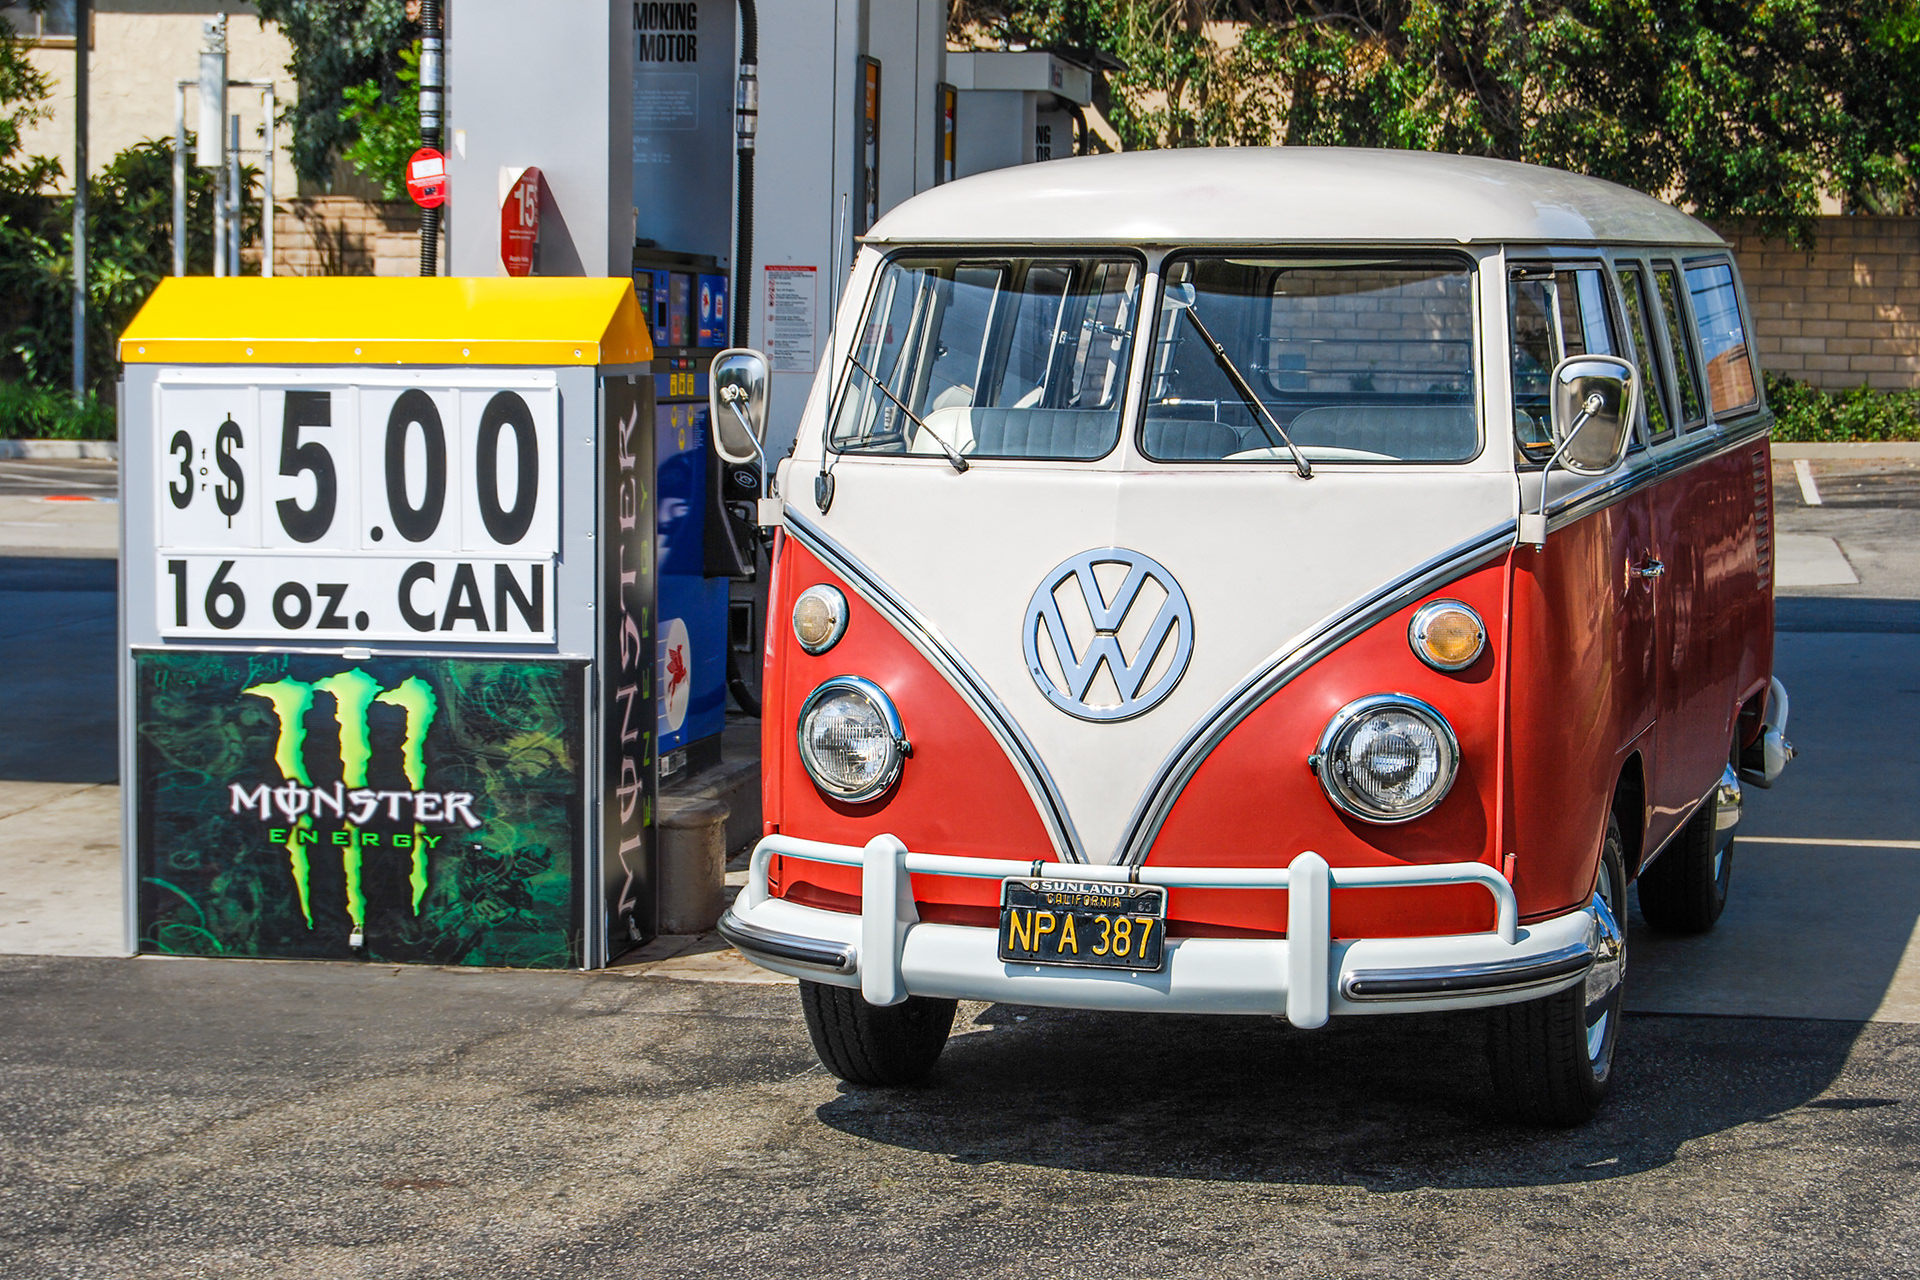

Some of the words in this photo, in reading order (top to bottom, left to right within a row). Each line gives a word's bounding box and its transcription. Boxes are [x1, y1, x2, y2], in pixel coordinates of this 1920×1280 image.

[640, 33, 697, 63] MOTOR
[169, 429, 194, 510] 3
[200, 448, 208, 491] for
[168, 560, 246, 630] 16
[272, 581, 370, 631] oz.
[398, 561, 544, 632] CAN
[616, 402, 643, 915] MONSTER
[1023, 546, 1195, 724] VW
[228, 780, 482, 828] MONSTER
[269, 828, 443, 849] ENERGY
[1041, 881, 1126, 896] SUNLAND
[1046, 893, 1121, 909] CALIFORNIA
[1008, 910, 1079, 955] NPA
[1092, 916, 1154, 959] 387
